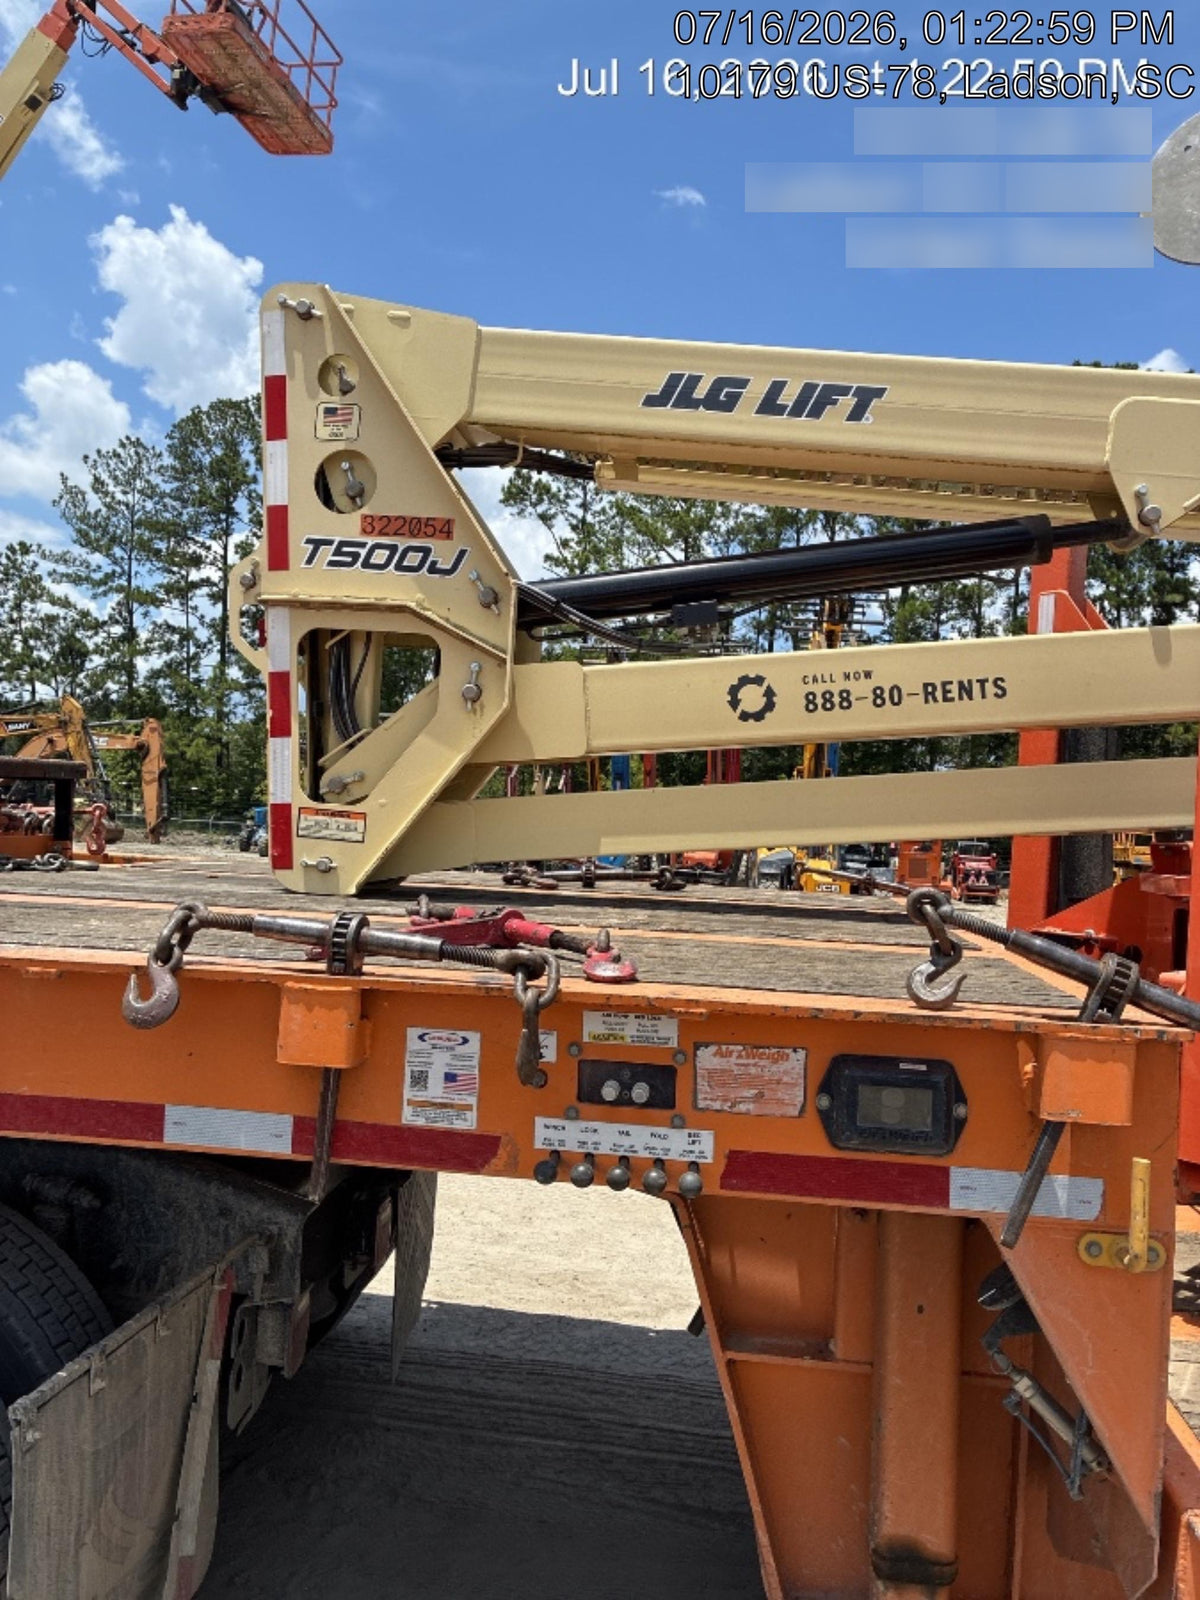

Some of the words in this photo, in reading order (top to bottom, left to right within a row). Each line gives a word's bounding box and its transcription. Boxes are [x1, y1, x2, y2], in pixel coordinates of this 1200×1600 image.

[640, 370, 754, 414] JLG
[752, 378, 891, 424] LIFT
[361, 515, 454, 539] 322054
[301, 536, 470, 577] T500J
[802, 673, 837, 685] CALL
[843, 669, 874, 682] NOW
[803, 676, 1009, 714] 888-80-RENTS
[815, 884, 840, 892] JCB
